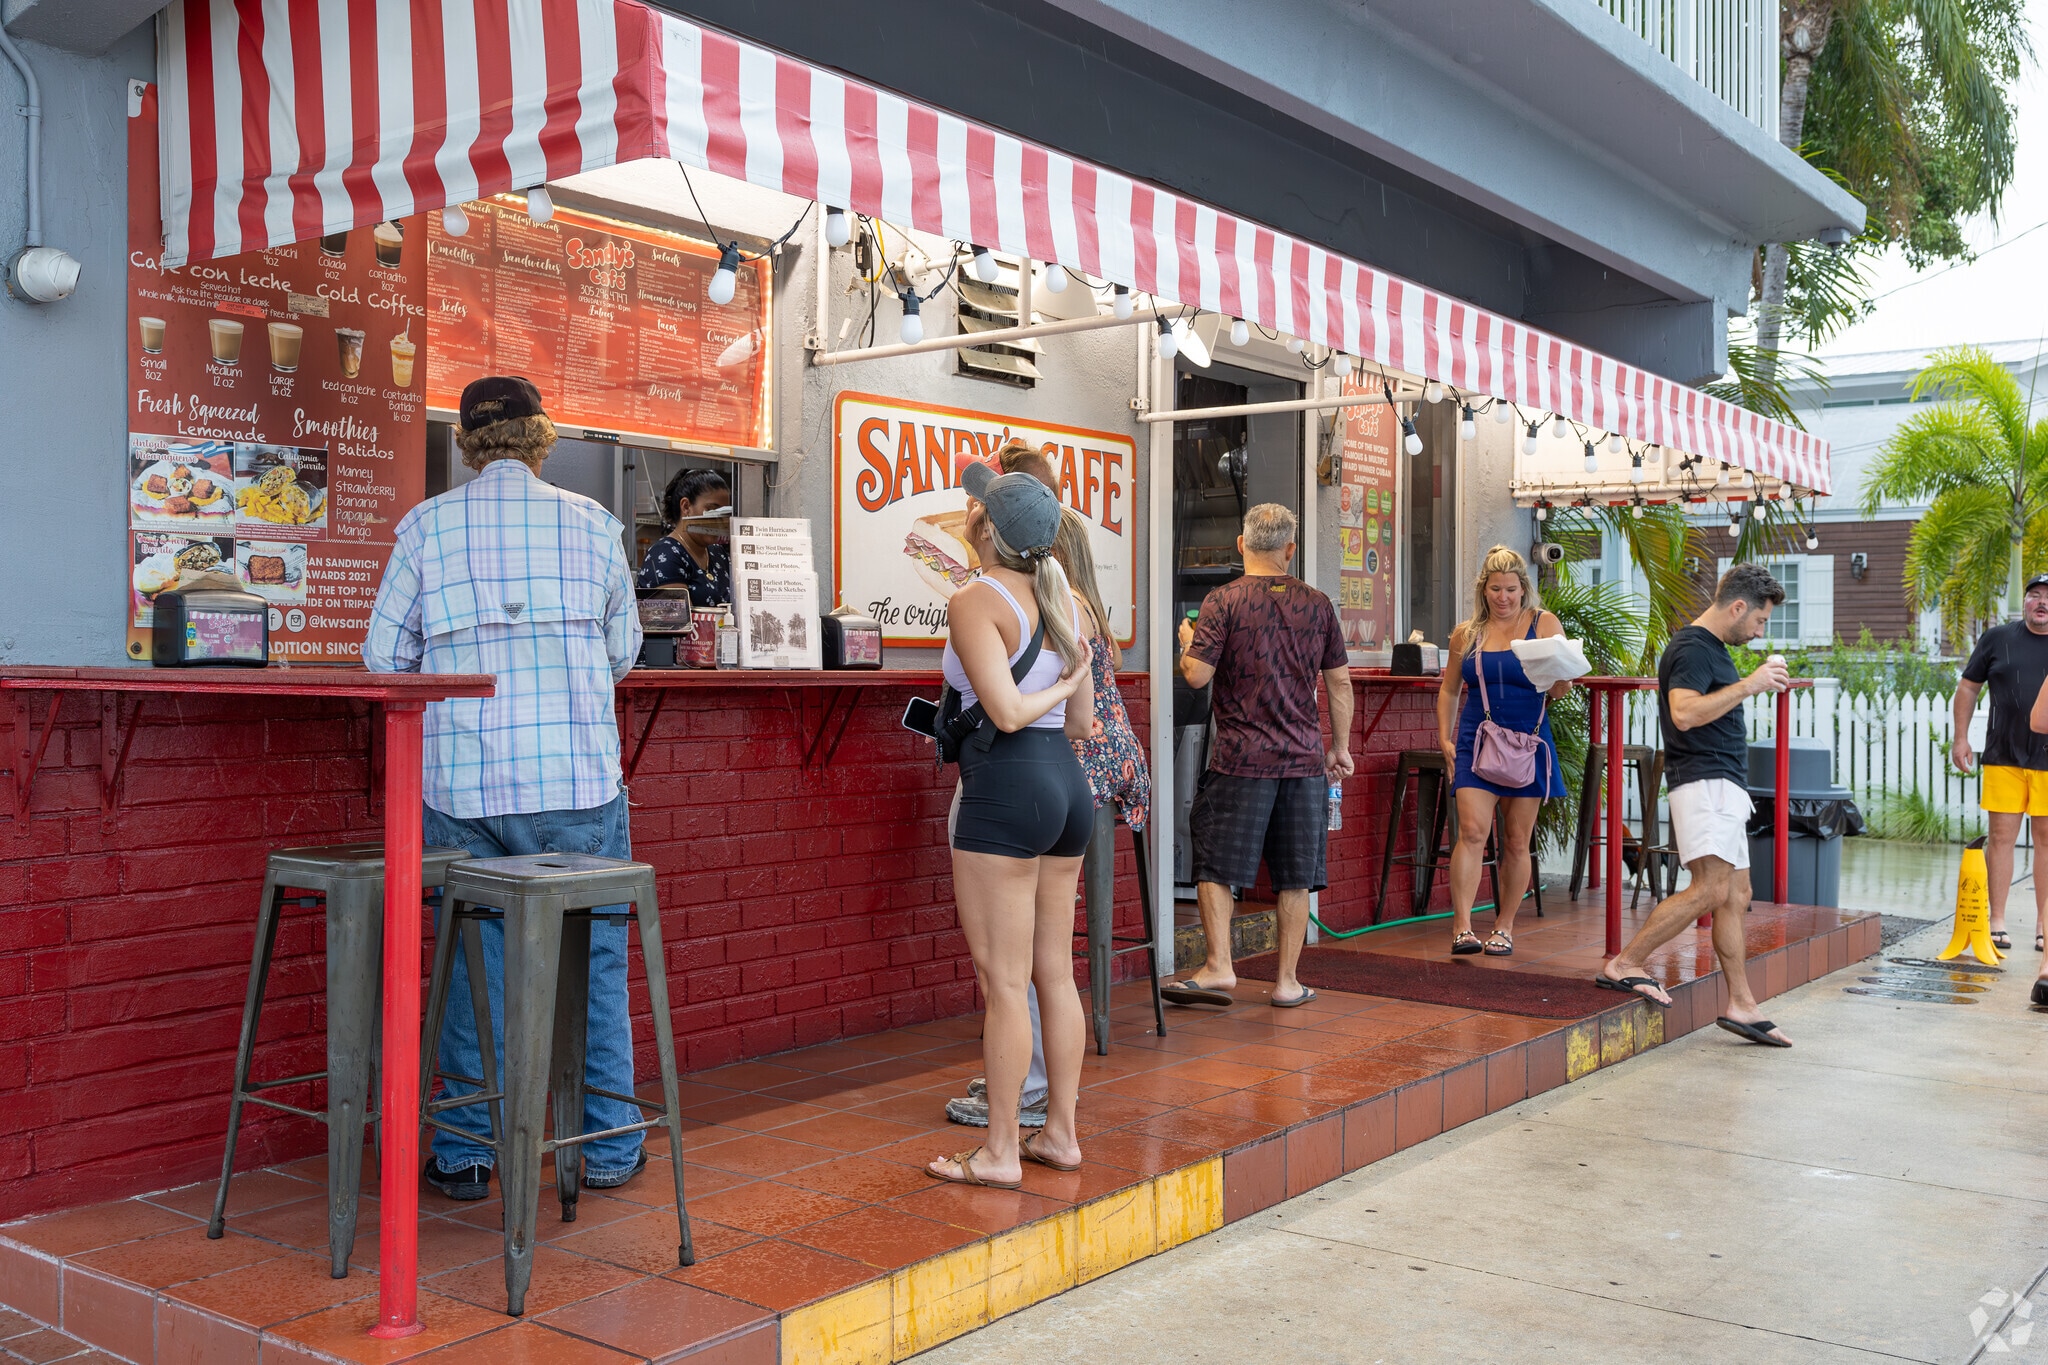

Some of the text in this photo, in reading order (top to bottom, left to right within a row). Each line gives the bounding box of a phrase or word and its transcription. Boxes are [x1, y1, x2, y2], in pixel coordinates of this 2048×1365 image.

[430, 239, 476, 265] Omelettes
[565, 237, 635, 271] Sandy's
[651, 248, 682, 268] Salads
[318, 255, 347, 271] Colada
[502, 249, 561, 275] Sandwiches
[189, 265, 231, 283] con
[589, 268, 626, 291] Café
[171, 284, 185, 294] Ask
[186, 287, 198, 297] for
[213, 292, 242, 304] regular
[252, 298, 270, 307] dark
[227, 285, 242, 295] hot
[637, 288, 676, 307] Homemade
[138, 287, 159, 300] Whole
[177, 295, 206, 307] Almond
[269, 309, 286, 319] free
[285, 311, 300, 321] milk
[316, 283, 426, 318] Cold Coffee
[440, 297, 469, 318] Sides
[140, 356, 168, 371] Small
[205, 363, 243, 378] Medium
[213, 375, 222, 387] 12
[268, 373, 295, 389] Large
[322, 379, 377, 397] Iced con leche
[137, 388, 261, 426] Fresh Squeezed
[340, 393, 348, 404] 16
[388, 400, 416, 413] Batido
[177, 420, 268, 444] Lemonade
[292, 407, 381, 443] Smoothies
[337, 442, 395, 460] Batidos
[1343, 439, 1390, 456] HOME OF THE WORLD
[277, 451, 319, 464] California
[297, 461, 327, 471] Burrito
[1344, 450, 1388, 466] FAMOUS & MULTIPLE
[336, 465, 373, 484] Mamey
[1358, 463, 1376, 475] WINNER
[1375, 467, 1392, 478] CUBAN
[1353, 474, 1379, 487] SANDWICH
[335, 481, 396, 501] Strawberry
[1041, 442, 1123, 537] AFE
[336, 495, 378, 508] Banana
[336, 508, 374, 526] Papaya
[337, 524, 372, 541] Mango
[768, 526, 798, 534] Hurricanes
[325, 557, 379, 570] SANDWICH
[306, 570, 371, 582] AWARDS 2021
[318, 585, 336, 595] THE
[338, 586, 357, 596] TOP
[360, 587, 378, 597] 10%
[325, 598, 341, 608] ON
[868, 596, 950, 635] The Origi
